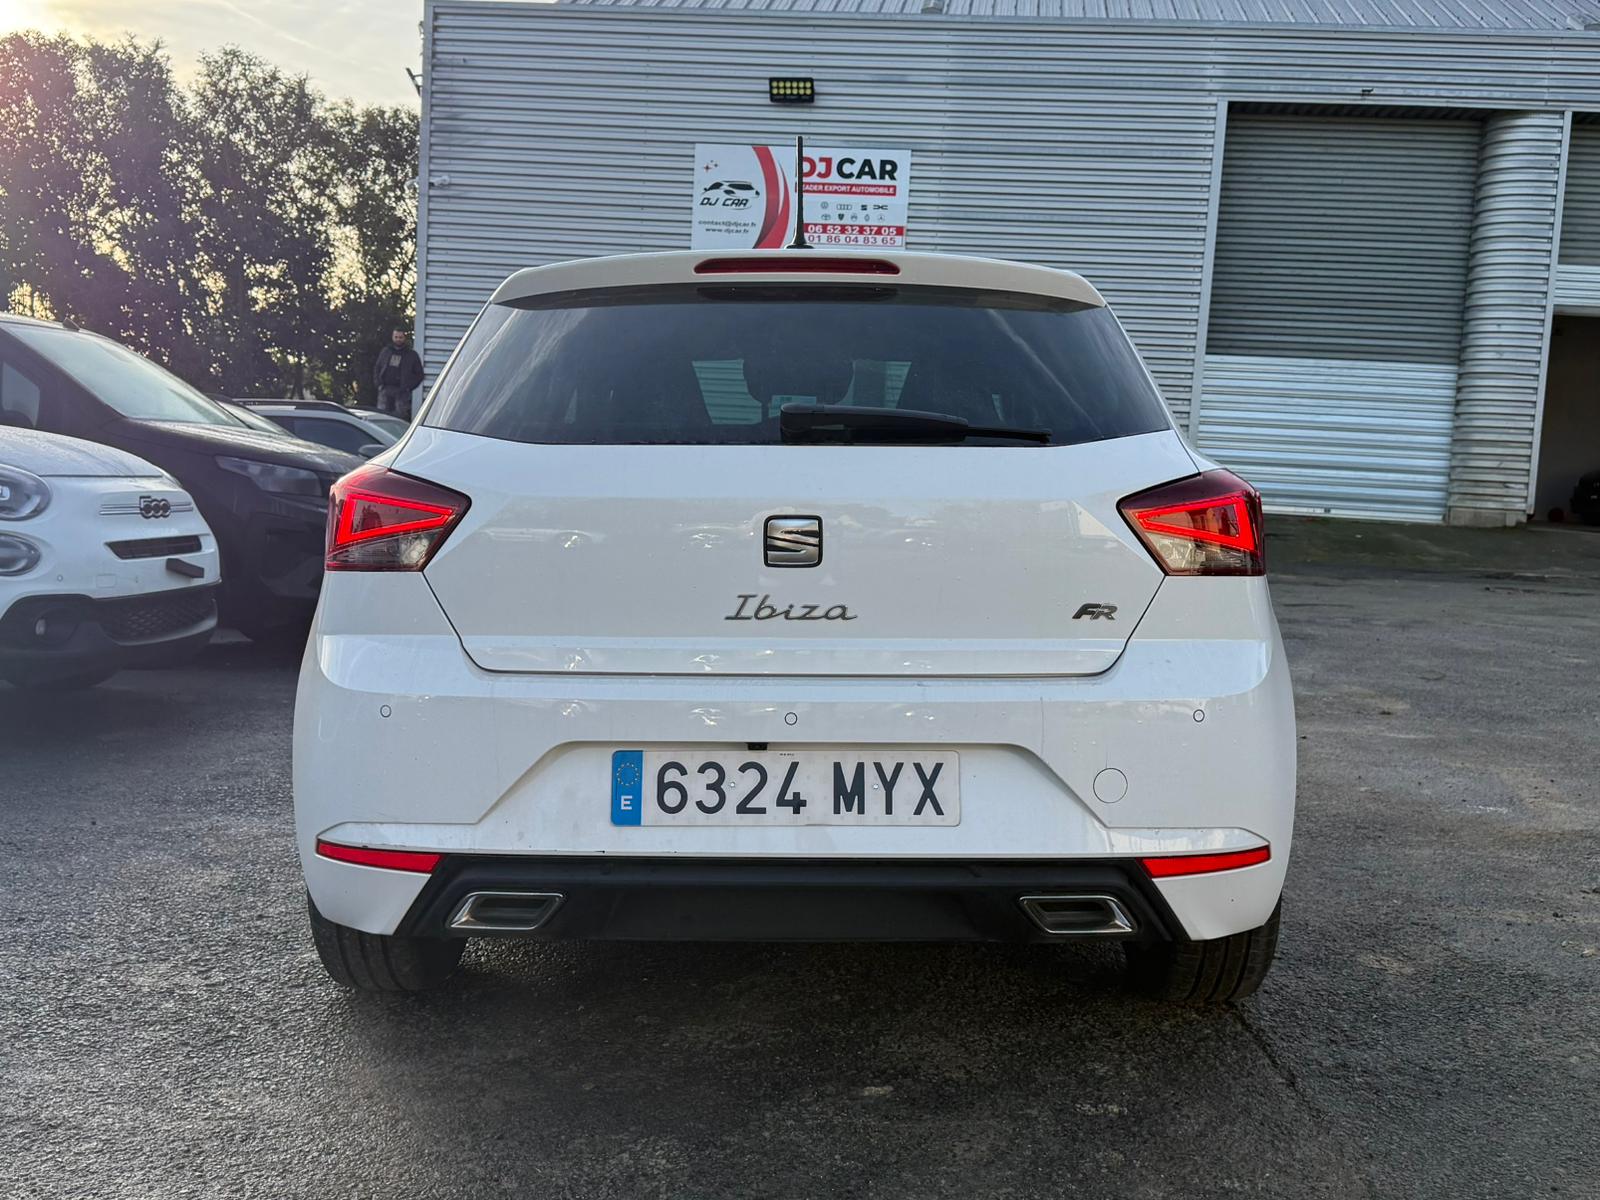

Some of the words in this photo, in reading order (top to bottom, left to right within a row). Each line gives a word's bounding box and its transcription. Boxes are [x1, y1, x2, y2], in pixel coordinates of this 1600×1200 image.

[795, 156, 832, 179] DJ
[836, 157, 898, 181] CAR
[851, 186, 895, 194] AUTOMOBILE
[699, 197, 720, 206] DJ
[722, 198, 750, 208] CAR
[808, 225, 823, 234] 06
[826, 225, 841, 234] 52
[844, 226, 860, 235] 32
[863, 226, 878, 235] 37
[881, 227, 897, 236] 05
[808, 234, 821, 243] 01
[826, 235, 841, 243] 86
[844, 236, 859, 244] 04
[863, 236, 877, 245] 83
[881, 237, 896, 245] 65
[139, 495, 171, 519] 500
[724, 594, 858, 621] Ibiza
[1071, 602, 1118, 621] FR
[656, 761, 807, 815] 6324
[832, 761, 945, 816] MYX
[620, 796, 633, 811] E
